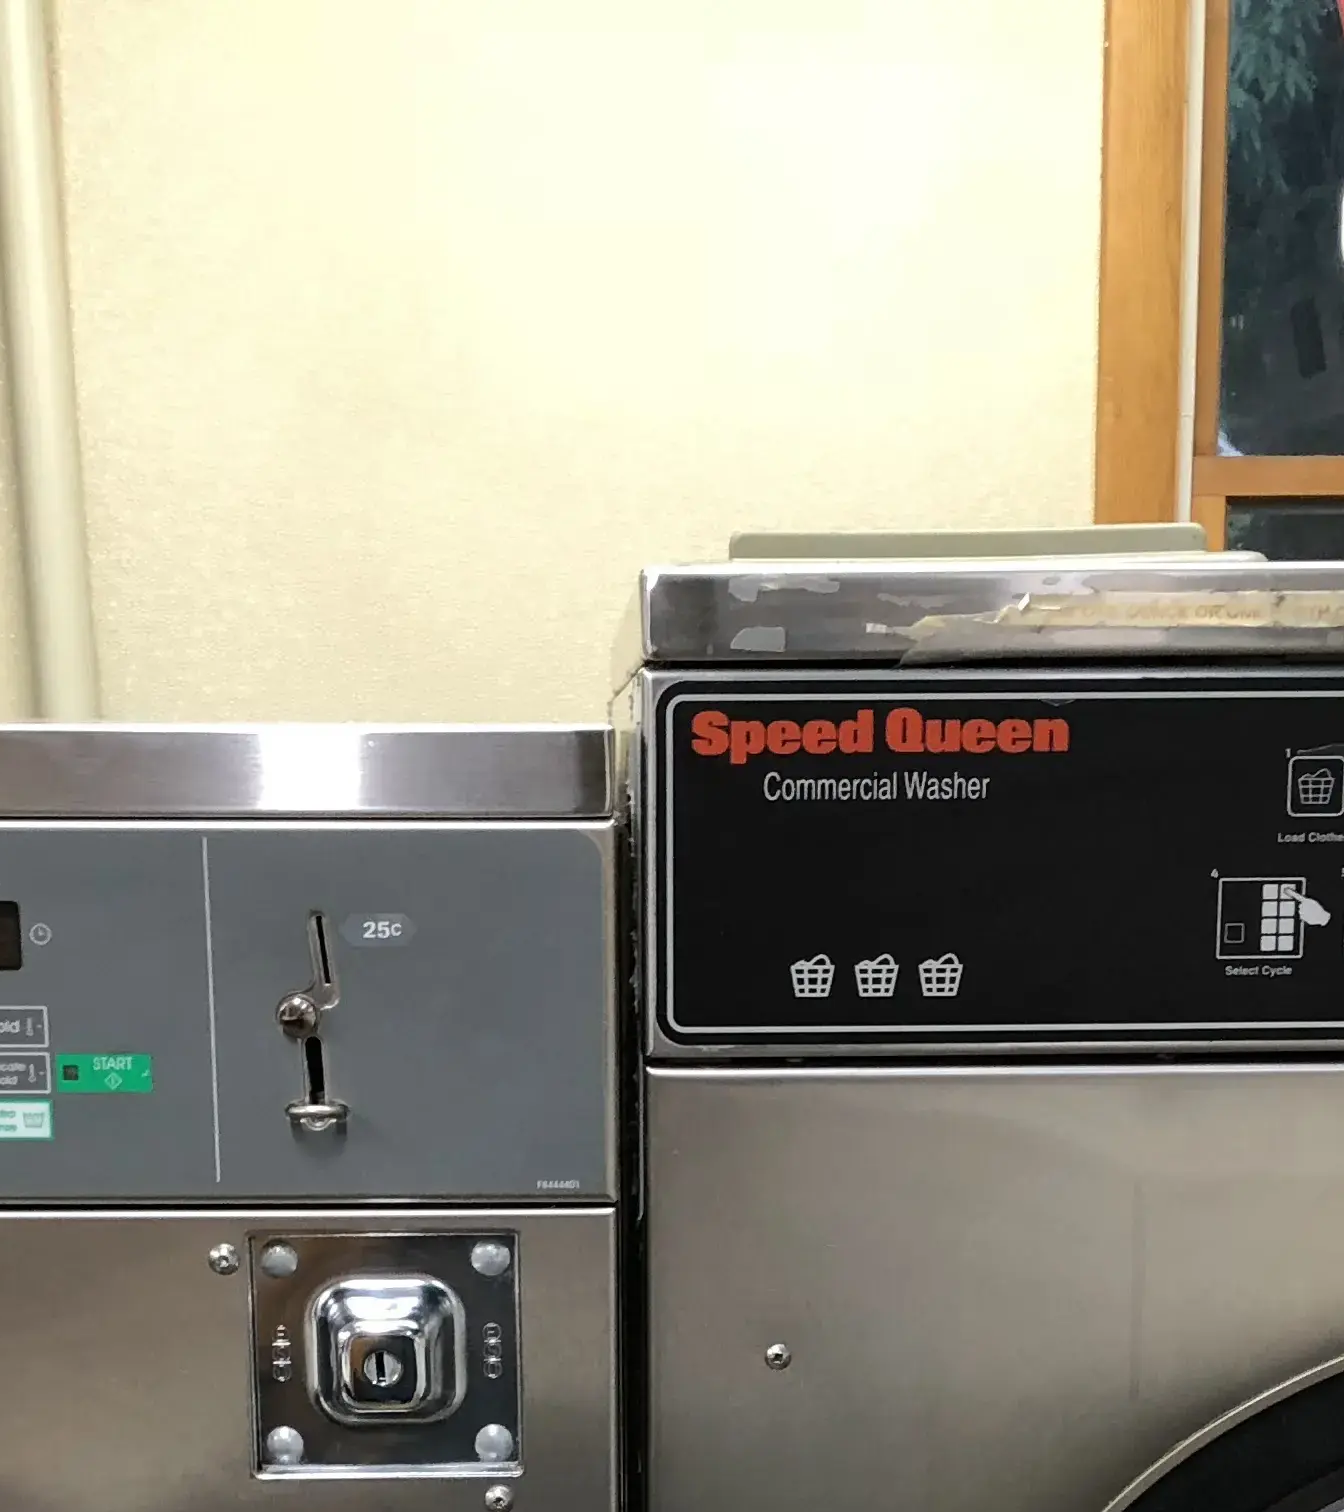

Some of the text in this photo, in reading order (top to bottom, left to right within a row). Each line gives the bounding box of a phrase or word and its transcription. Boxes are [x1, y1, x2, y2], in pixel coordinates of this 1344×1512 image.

[691, 707, 1070, 764] Speed Queen
[763, 771, 990, 801] Commercial Washer
[1278, 832, 1305, 843] Load
[1225, 965, 1292, 977] Select Cycle
[92, 1056, 133, 1071] START
